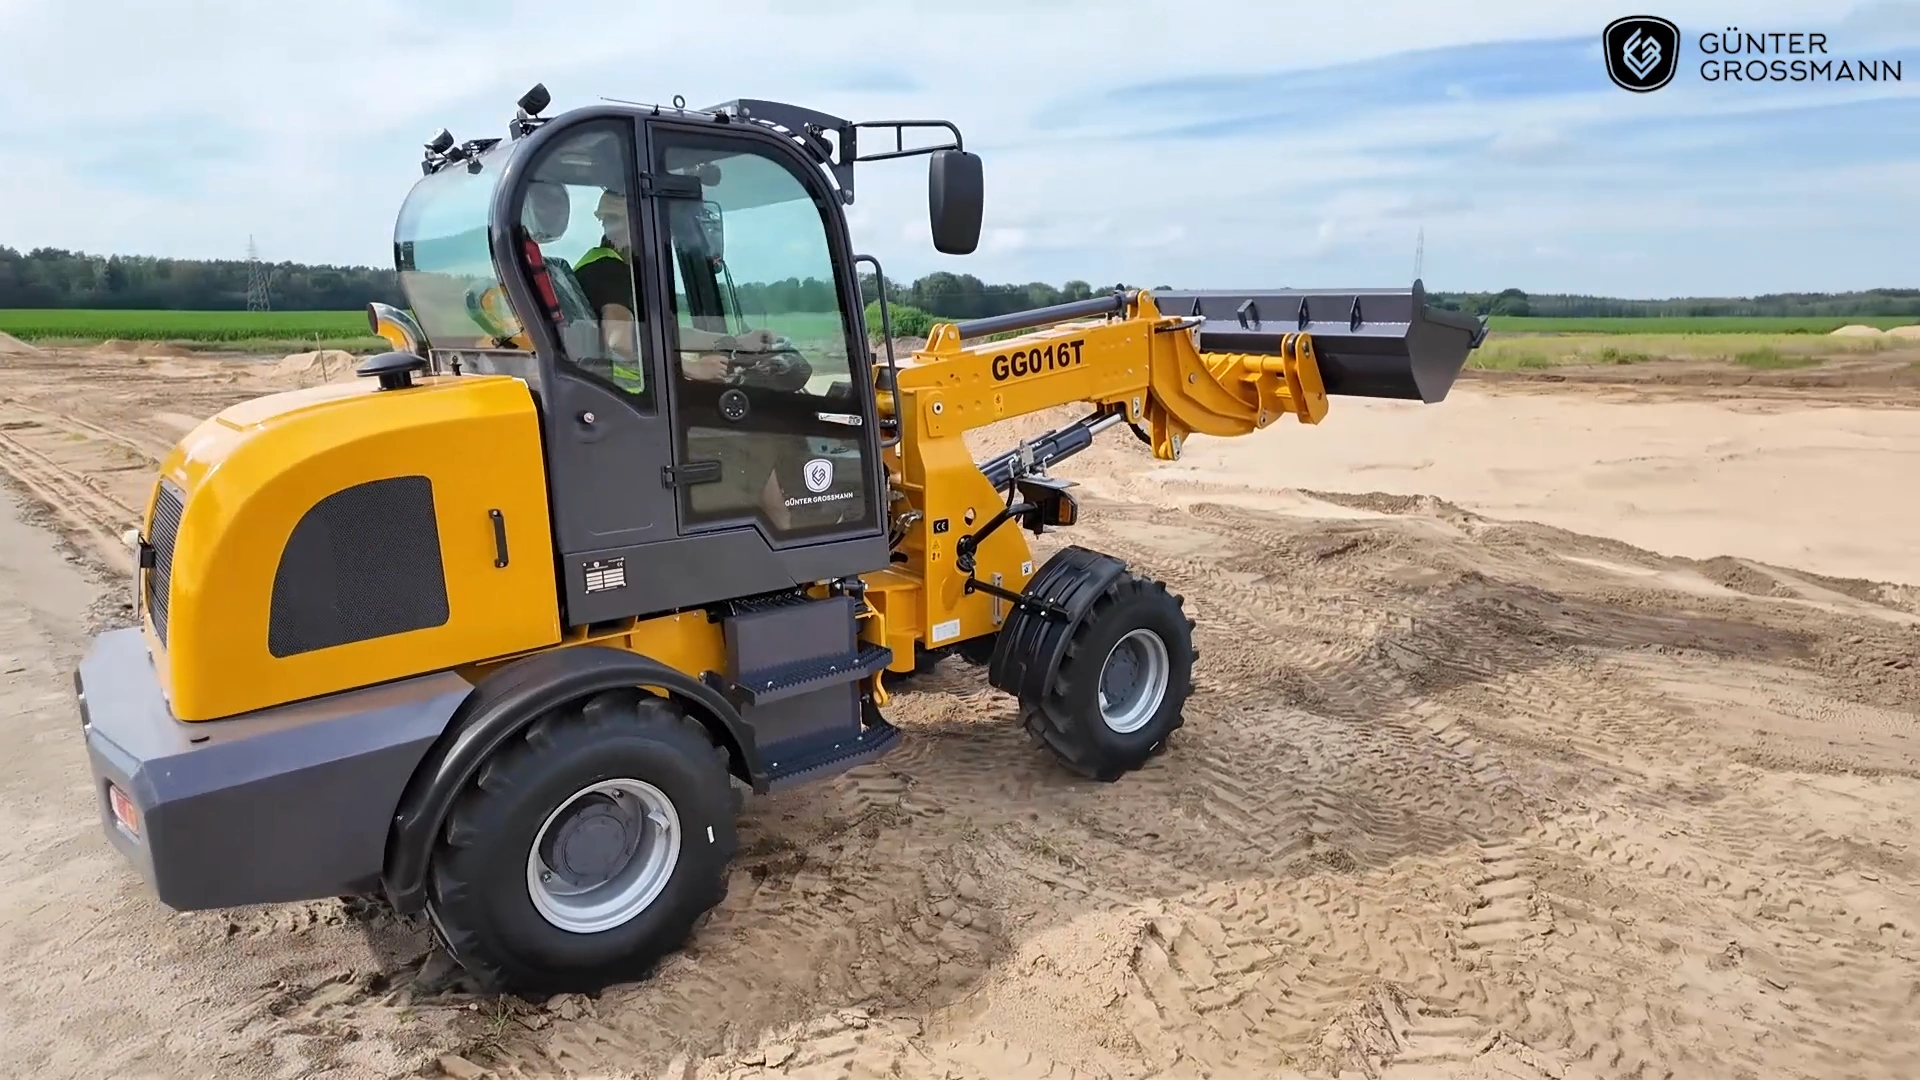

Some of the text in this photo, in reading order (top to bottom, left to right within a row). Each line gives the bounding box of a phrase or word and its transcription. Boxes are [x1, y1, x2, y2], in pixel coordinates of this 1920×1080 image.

[991, 339, 1085, 381] GG016T
[784, 491, 854, 507] GÜNTER GROSSMANN
